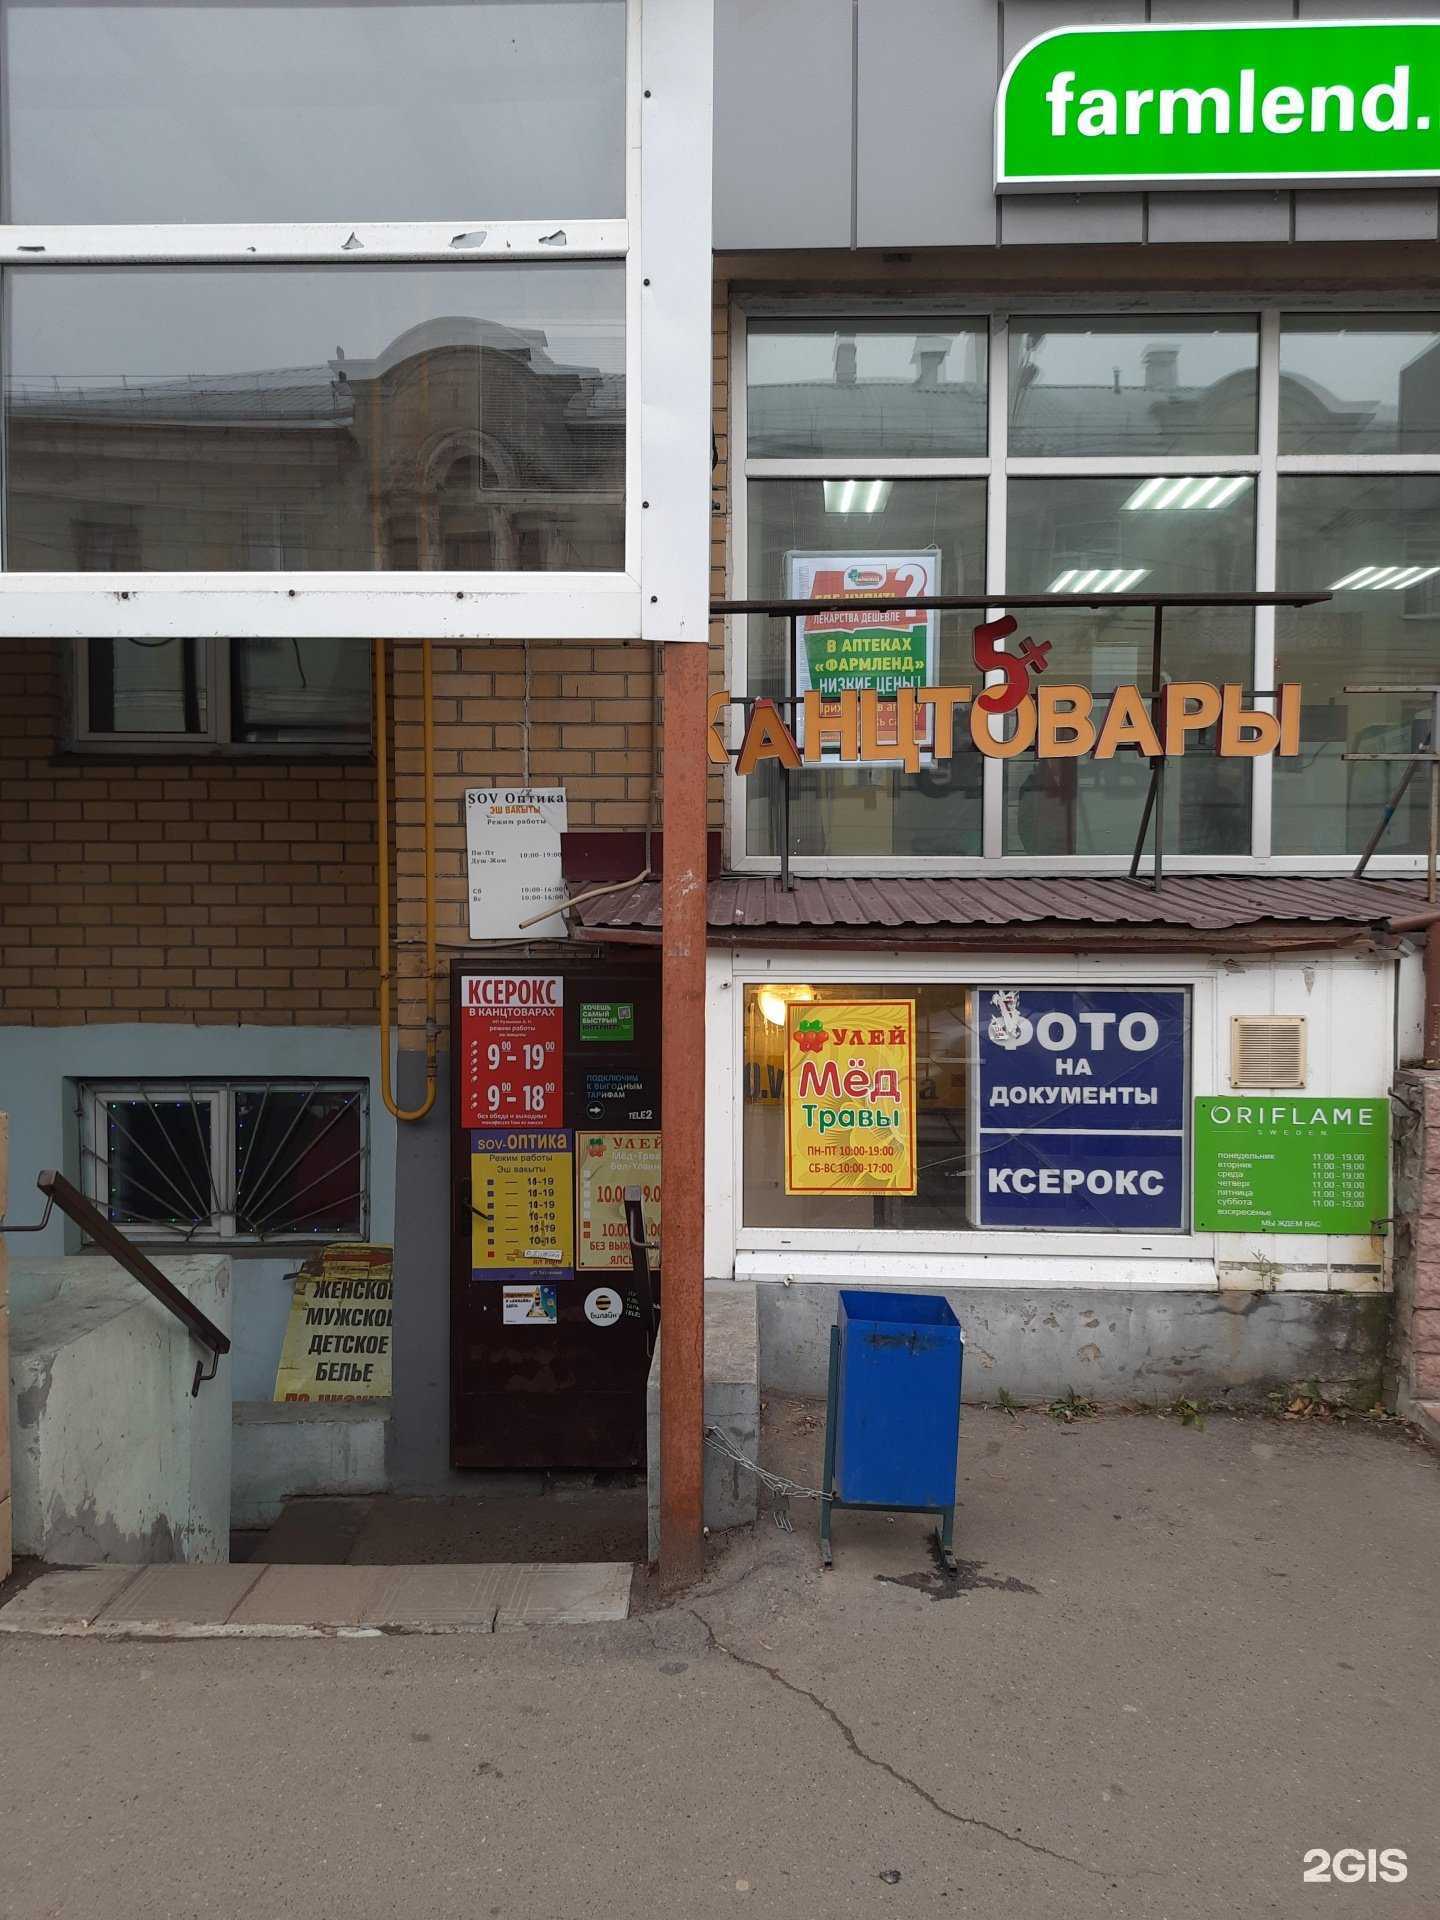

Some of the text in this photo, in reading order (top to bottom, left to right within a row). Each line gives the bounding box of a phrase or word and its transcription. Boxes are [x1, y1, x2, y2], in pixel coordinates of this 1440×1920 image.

[1046, 65, 1430, 137] farmlend.
[813, 611, 900, 624] ЛЕКАРСТВА ДЕШЕВЛЕ
[827, 638, 912, 652] В АПТЕКАХ
[815, 657, 924, 672] «ФАРМЛЕНД»
[820, 677, 871, 693] НИЗКИЕ
[468, 793, 564, 804] SOV Оптика
[517, 818, 546, 826] работы
[468, 979, 556, 1005] КСЕРОКС
[469, 1008, 555, 1018] В КАНЦТОВАРАХ
[831, 1025, 906, 1046] УЛЕЙ
[987, 1010, 1160, 1052] ФОТО
[1056, 1058, 1092, 1076] НА
[799, 1059, 901, 1103] Мёд
[989, 1086, 1158, 1107] ДОКУМЕНТЫ
[629, 1110, 653, 1120] TELE2
[802, 1104, 899, 1133] Травы
[1210, 1105, 1374, 1126] ORIFLAME
[807, 1145, 894, 1156] ПН-ПТ 10:00-19:00
[808, 1162, 893, 1174] СБ-ВС 10:00-17:00
[988, 1167, 1164, 1196] КСЕРОКС
[590, 1241, 606, 1250] БЕЗ
[308, 1335, 389, 1355] ДЕТСКОЕ
[315, 1362, 374, 1382] БЕЛЬЕ
